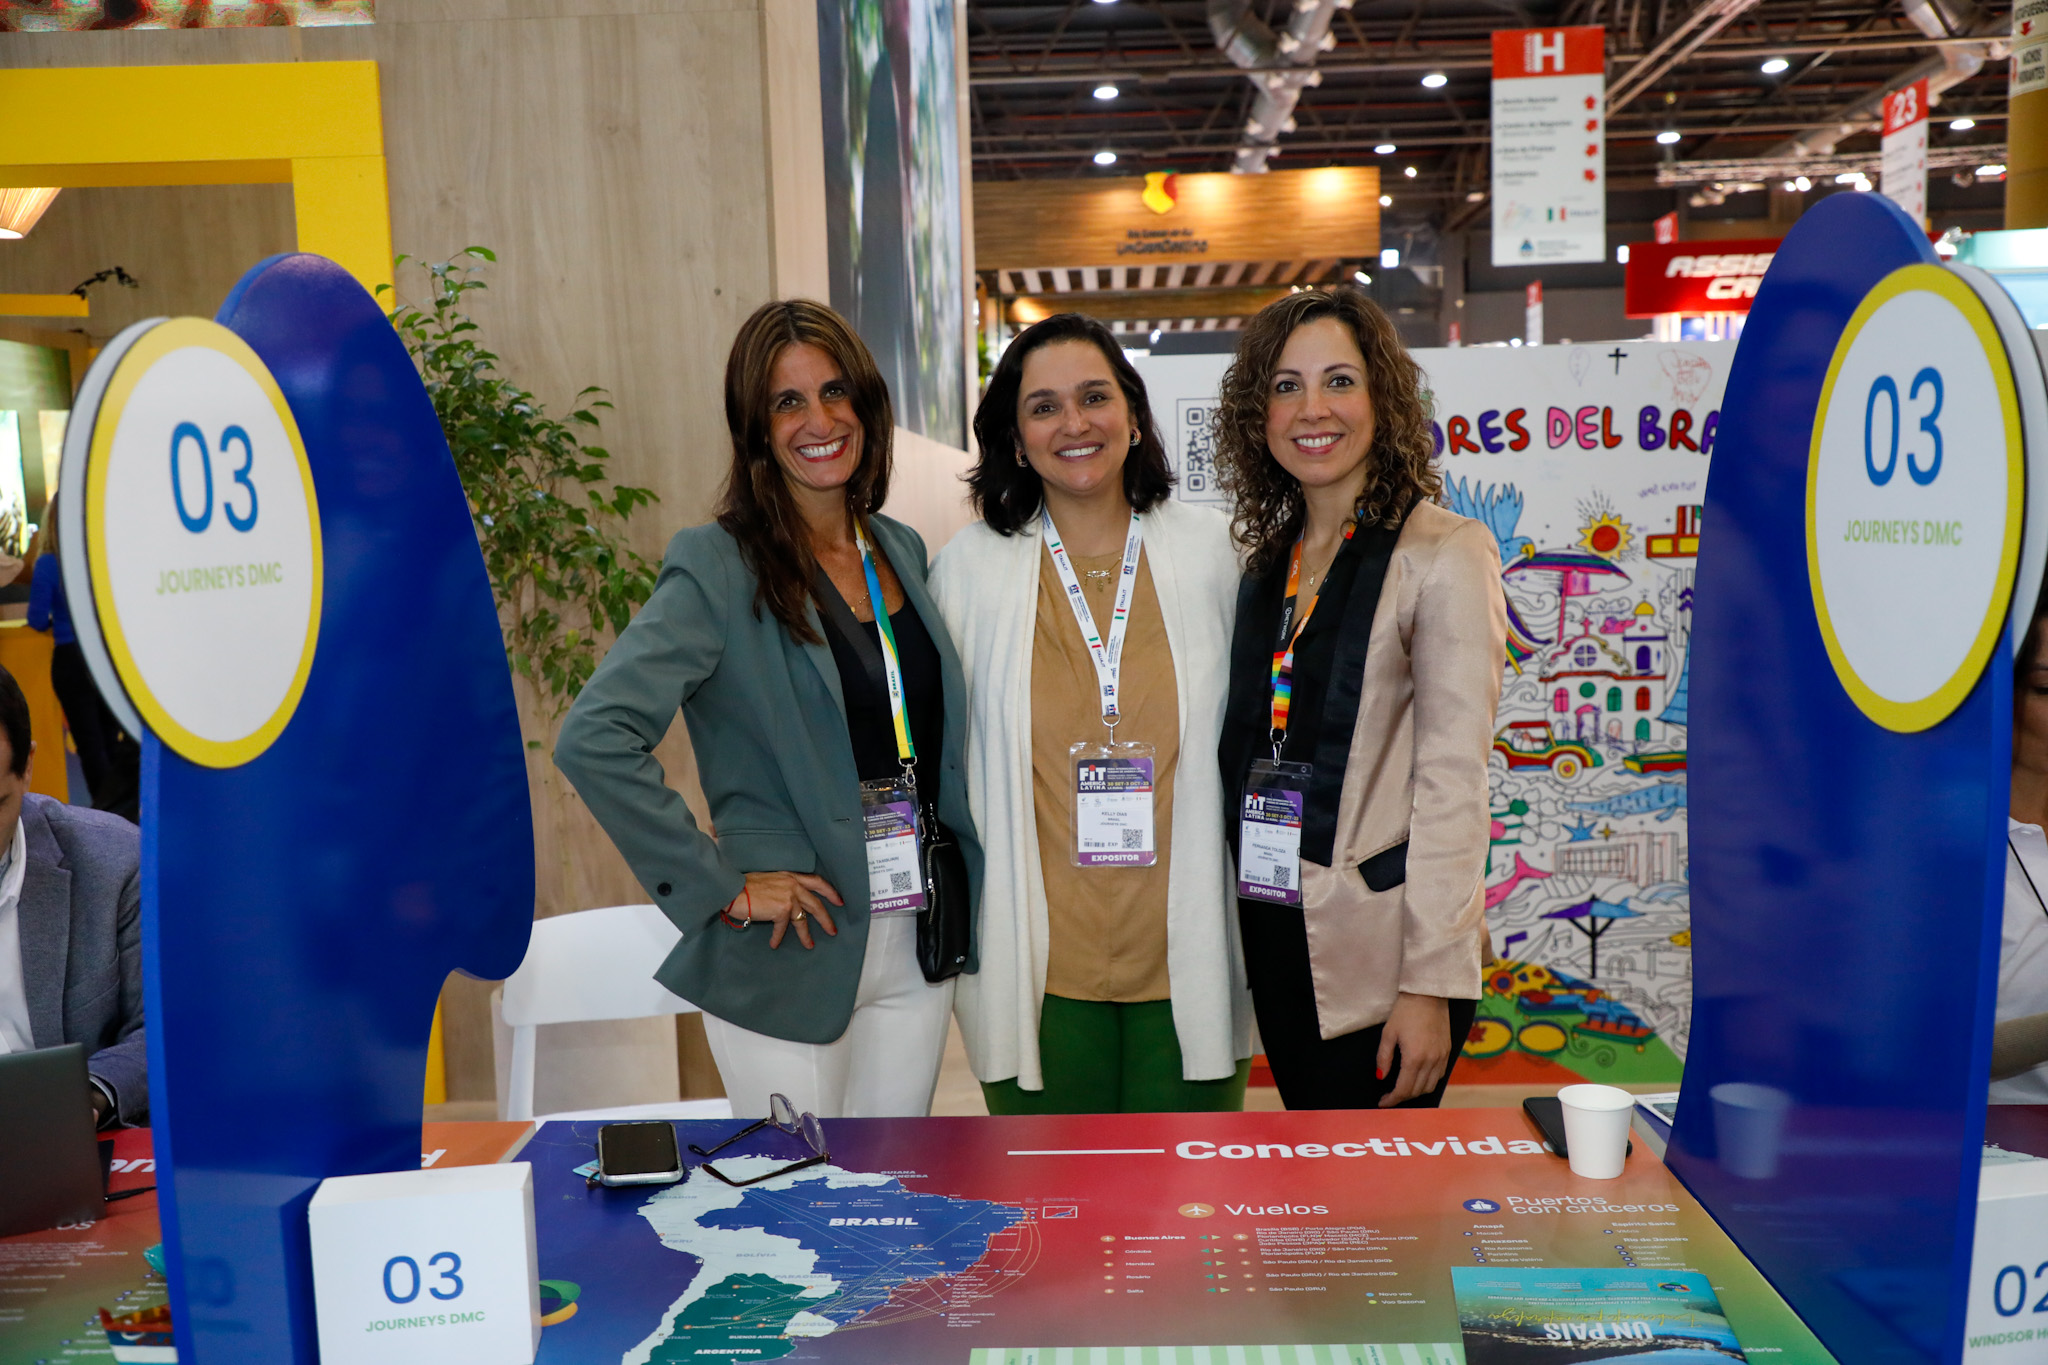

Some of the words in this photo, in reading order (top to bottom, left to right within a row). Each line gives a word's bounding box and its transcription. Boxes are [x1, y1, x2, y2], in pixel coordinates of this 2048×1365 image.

[1533, 31, 1565, 73] H
[1892, 86, 1918, 128] 23
[1666, 252, 1776, 278] ASSIS
[1706, 277, 1764, 299] CA
[1547, 406, 1623, 450] DEL
[1864, 365, 1945, 487] 03
[169, 420, 259, 534] 03
[1843, 519, 1920, 545] JOURNEYS
[1923, 520, 1963, 547] DMC
[156, 564, 246, 596] JOURNEYS
[249, 561, 284, 587] DMC
[1091, 854, 1139, 862] EXPOSITOR
[1249, 885, 1287, 899] EXPOSITOR
[871, 898, 910, 911] POSITOR
[1223, 1202, 1330, 1216] Vuelos
[1506, 1195, 1607, 1206] Puertos
[1512, 1205, 1562, 1215] con
[1565, 1203, 1681, 1214] cruceros
[828, 1217, 919, 1227] BRASIL
[382, 1250, 465, 1305] 03
[365, 1314, 447, 1333] JOURNEYS
[449, 1310, 486, 1325] DMC
[1542, 1321, 1606, 1344] PAÍS
[1610, 1320, 1654, 1341] UN
[1968, 1329, 2034, 1349] WINDSOR
